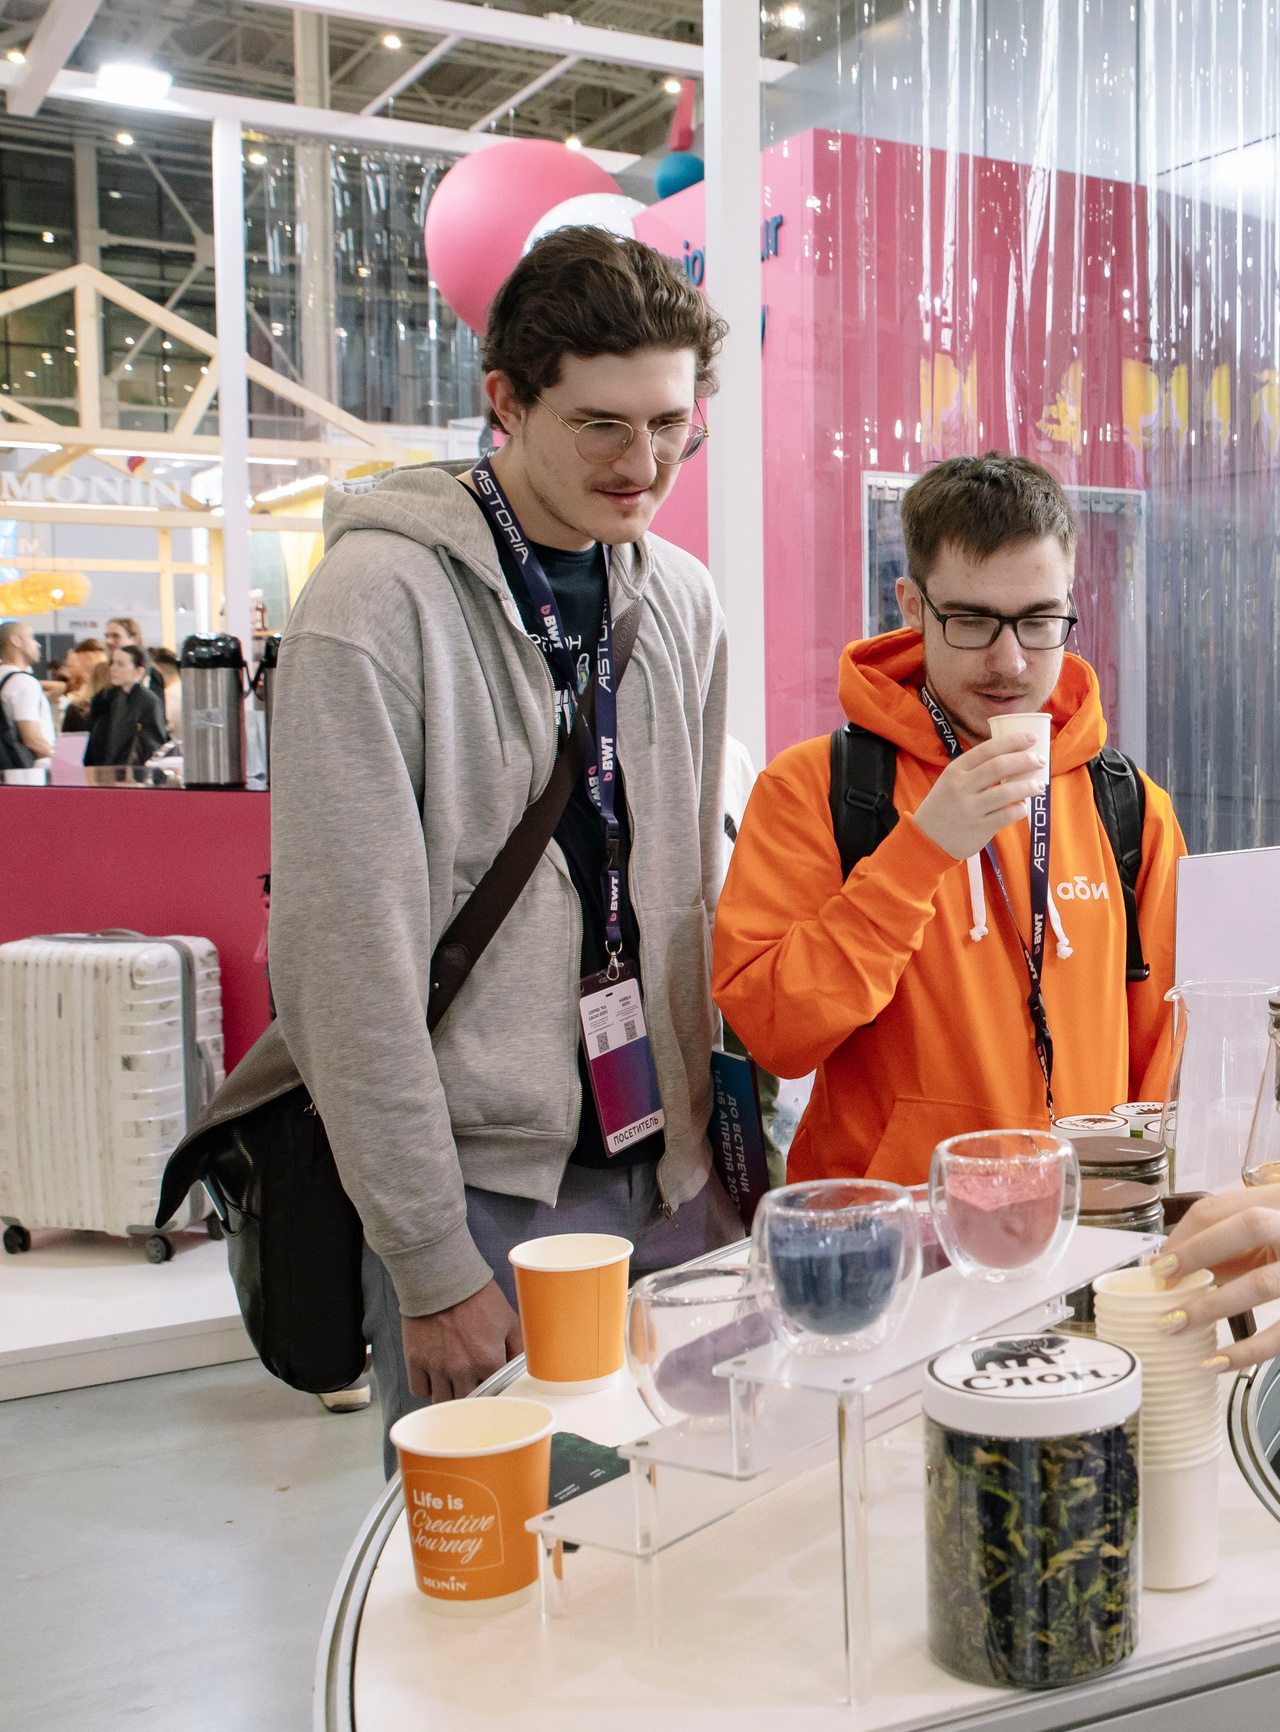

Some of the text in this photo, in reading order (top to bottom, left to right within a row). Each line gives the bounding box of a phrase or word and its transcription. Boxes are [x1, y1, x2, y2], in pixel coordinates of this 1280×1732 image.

[0, 470, 188, 508] MONIN
[475, 469, 530, 565] ASTORIA
[543, 614, 564, 650] BWT
[601, 736, 613, 771] BWT
[1034, 788, 1047, 873] ASTOR
[610, 876, 619, 911] BWT
[1056, 876, 1109, 900] аби
[1033, 913, 1044, 945] BWT
[613, 1116, 659, 1146] ПОСЕТИТЕЛЬ
[719, 1110, 735, 1173] АПРЕЛЯ
[727, 1093, 750, 1193] ДО ВСТРЕЧИ
[413, 1488, 464, 1511] Life is
[412, 1509, 495, 1534] Creative
[411, 1528, 483, 1565] Journey
[423, 1576, 468, 1591] MONIN
